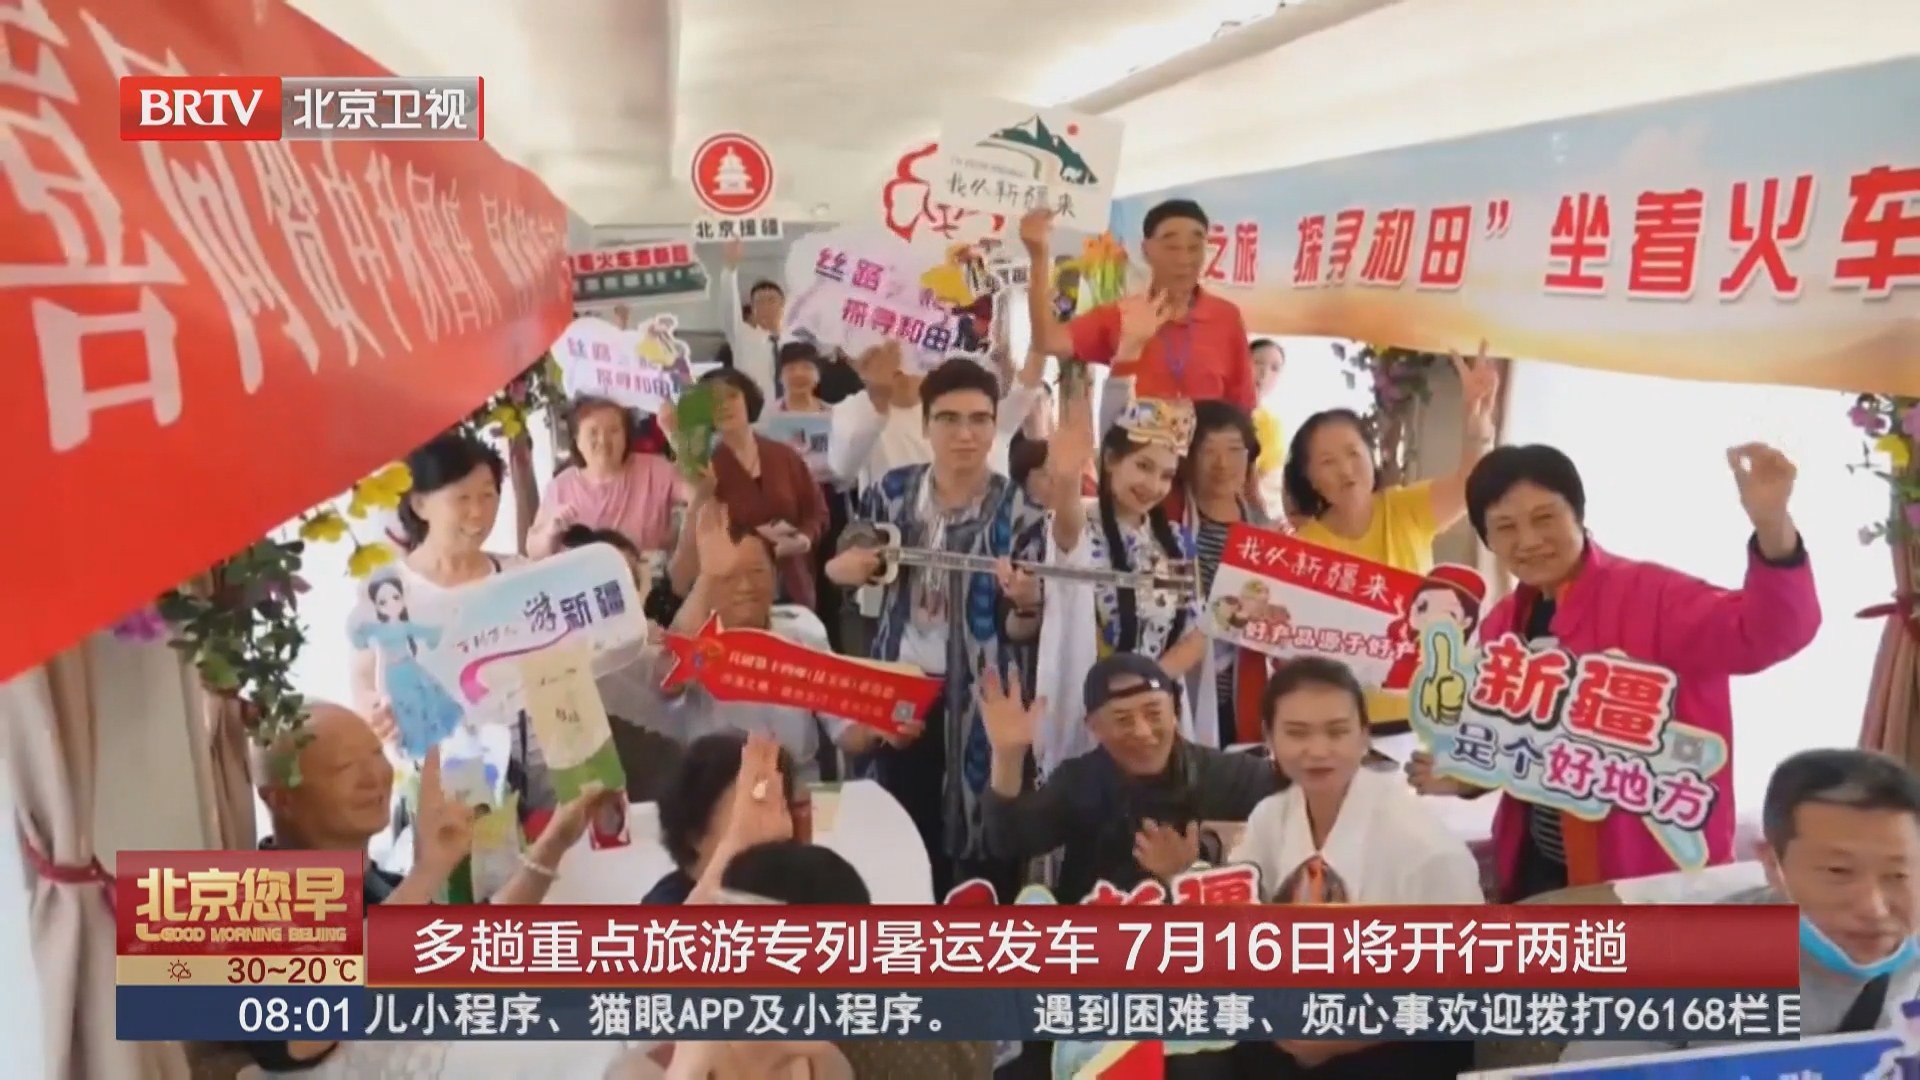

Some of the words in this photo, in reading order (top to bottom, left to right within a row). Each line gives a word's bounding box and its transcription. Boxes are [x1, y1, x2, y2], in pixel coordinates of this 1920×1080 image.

[1236, 536, 1389, 606] 我从新疆来
[1469, 636, 1671, 751] 新疆
[1453, 722, 1710, 825] 是个好地方
